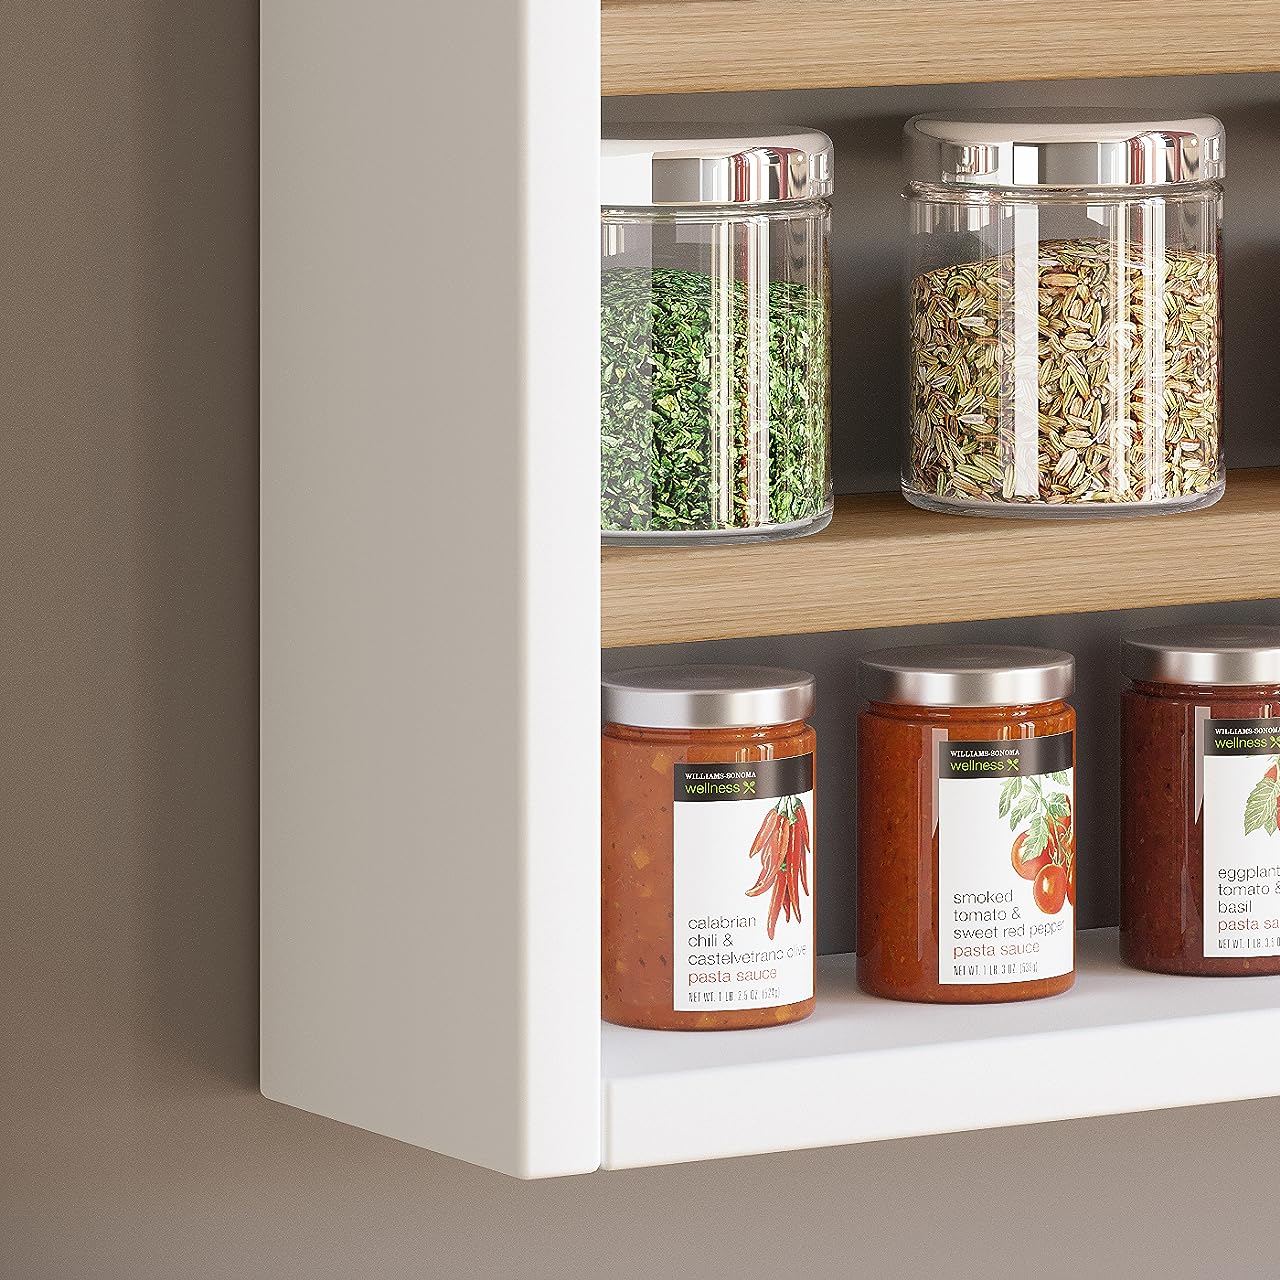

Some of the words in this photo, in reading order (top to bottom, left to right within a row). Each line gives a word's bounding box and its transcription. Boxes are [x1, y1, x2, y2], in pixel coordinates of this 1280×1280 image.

[1215, 737, 1267, 749] wellness
[950, 749, 1020, 757] WILLIAMS-SONOMA
[950, 760, 1004, 771] wellness
[685, 772, 756, 780] WILLIAMS-SONOMA
[685, 782, 741, 794] wellness
[1218, 883, 1270, 896] tomato
[953, 889, 1013, 904] smoked
[1218, 900, 1252, 913] basil
[953, 909, 1007, 922] tomato
[1011, 907, 1021, 920] &
[688, 916, 756, 929] calabrian
[1218, 918, 1259, 933] pasta
[953, 926, 998, 939] sweet
[1003, 924, 1025, 937] red
[688, 934, 717, 947] chili
[722, 933, 733, 947] &
[953, 944, 995, 959] pasta
[1000, 942, 1040, 956] sauce
[688, 952, 784, 966] castelvetrano
[689, 971, 731, 986] pasta
[736, 969, 777, 982] sauce
